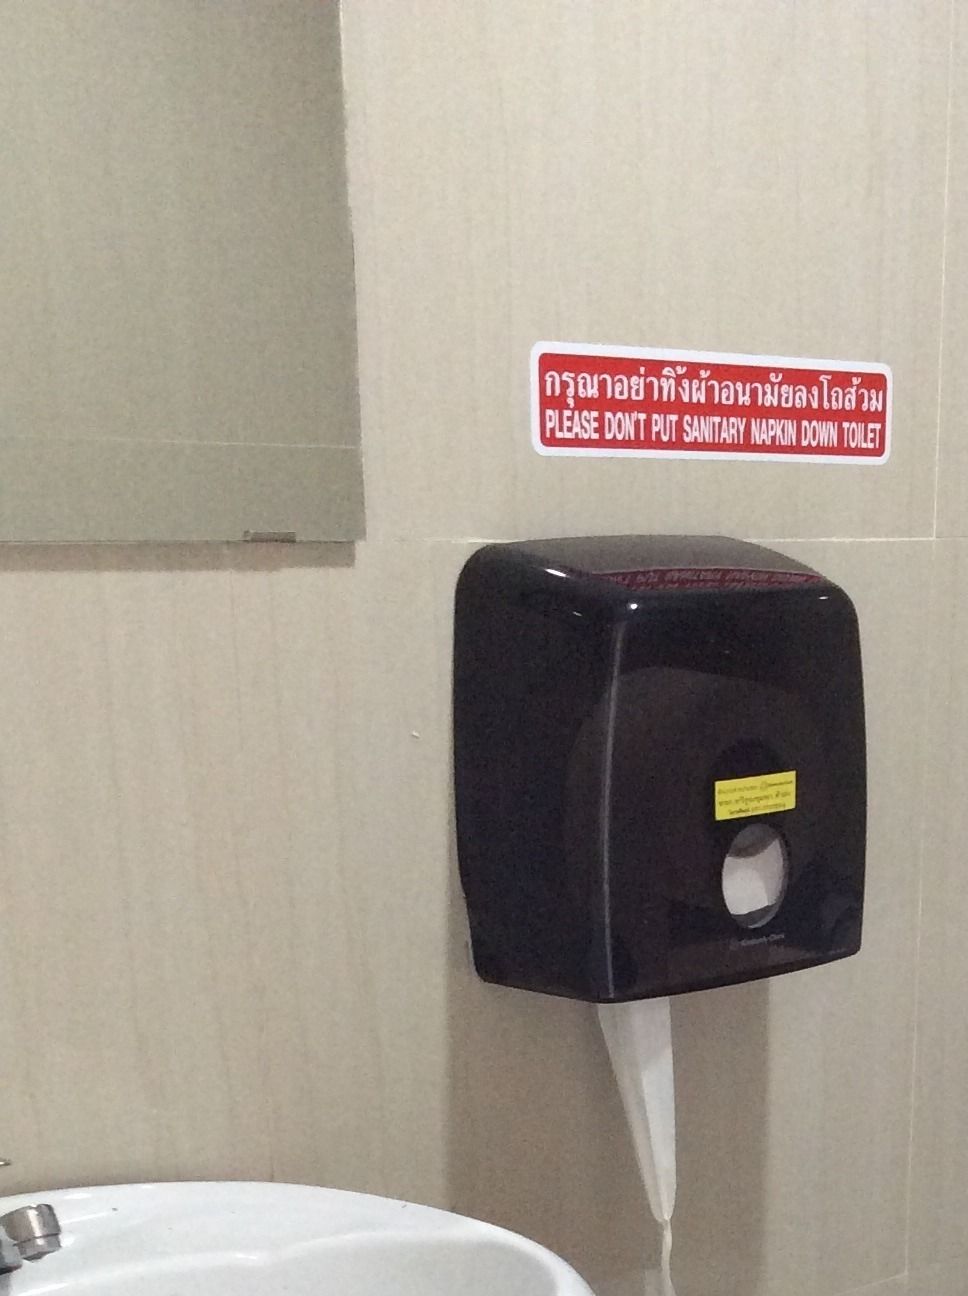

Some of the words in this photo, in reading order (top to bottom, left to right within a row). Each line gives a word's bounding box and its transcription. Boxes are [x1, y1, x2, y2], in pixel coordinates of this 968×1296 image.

[545, 365, 883, 412] กรุณาอย่าทิ้งผ้าอนามัยลงโถส้วม
[545, 409, 600, 440] PLEASE
[604, 411, 647, 441] DON'T
[651, 413, 679, 443] PUT
[683, 415, 746, 445] SANITARY
[750, 418, 797, 446] NAPKIN
[801, 420, 838, 448] DOWN
[842, 421, 882, 449] TOILET
